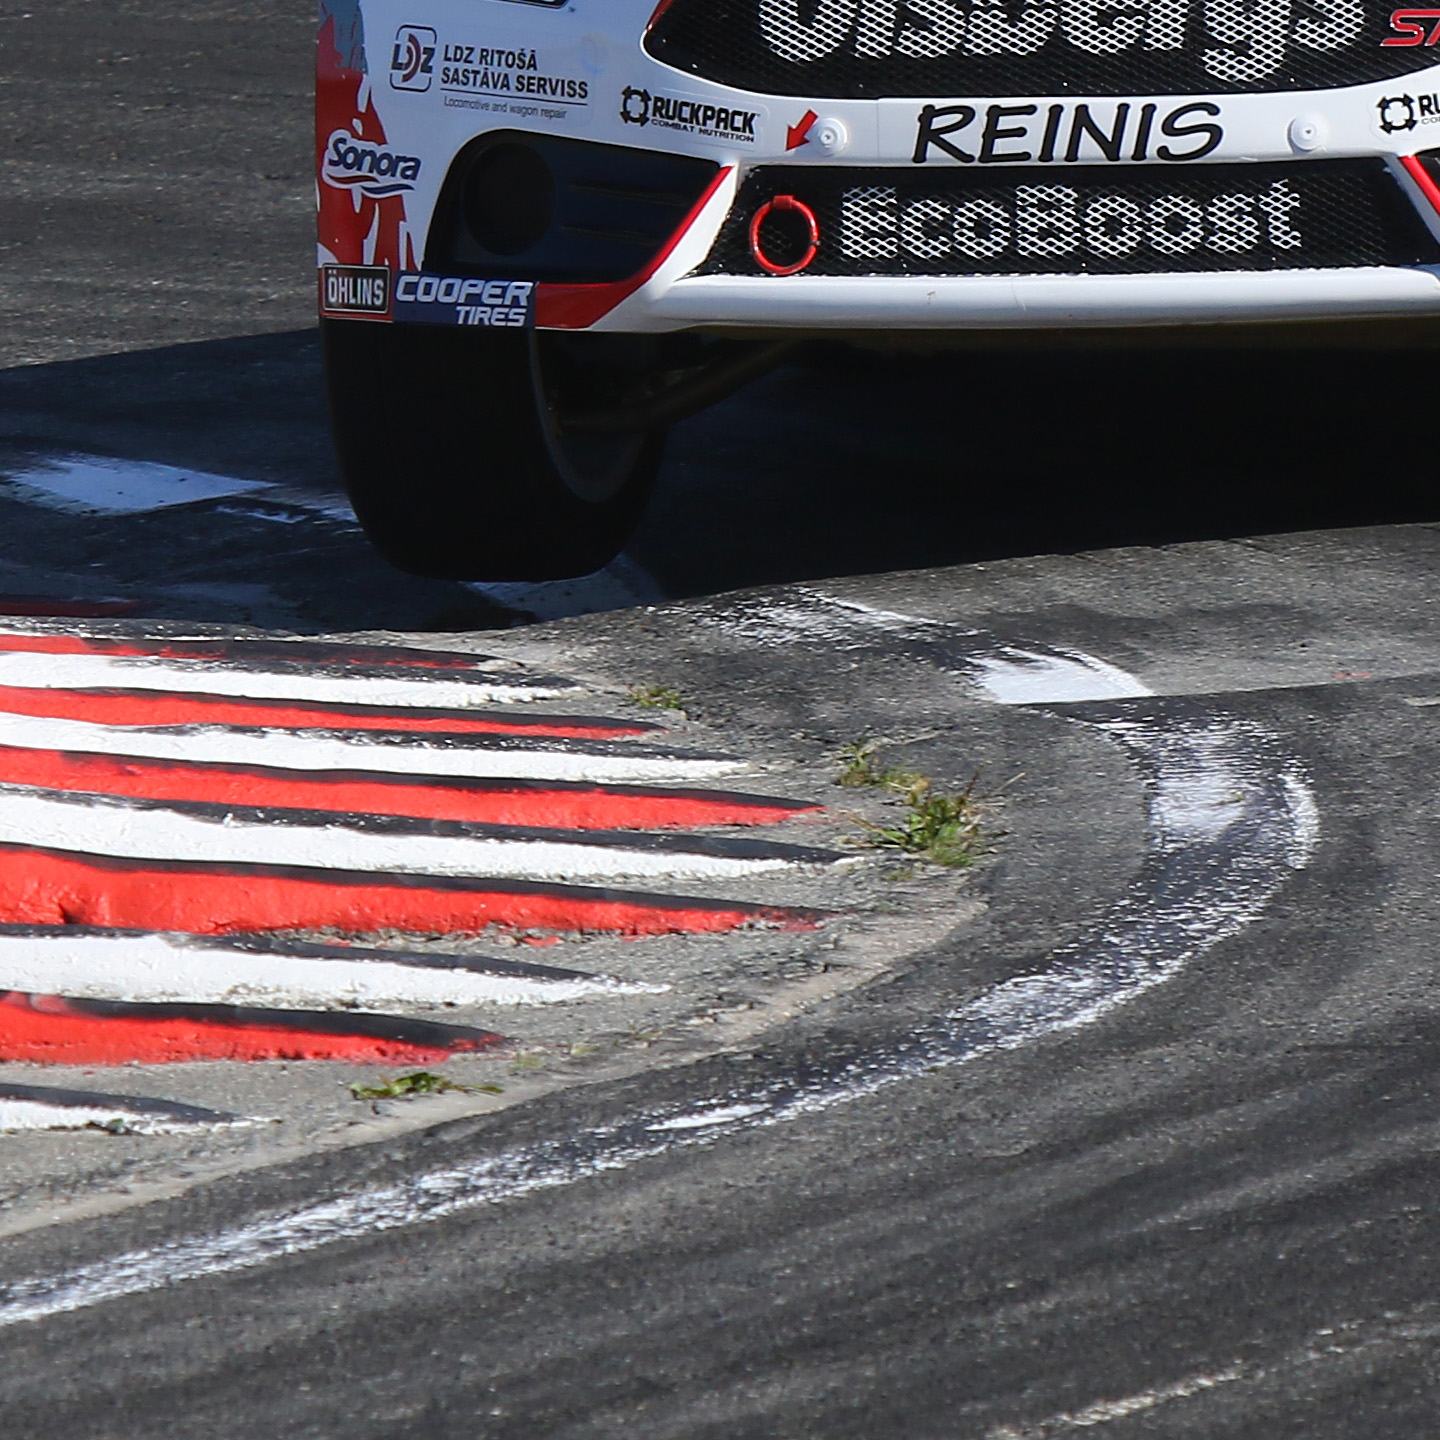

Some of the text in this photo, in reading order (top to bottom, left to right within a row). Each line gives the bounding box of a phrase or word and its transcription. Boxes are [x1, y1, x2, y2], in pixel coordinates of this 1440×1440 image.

[443, 45, 538, 71] LDZ RITOŠĀ
[441, 66, 588, 99] SASTĀVA SERVISS
[444, 95, 568, 120] Locomotive and wagon repair
[652, 96, 756, 135] RUCKPACK
[650, 117, 755, 143] COMBAT NUTRITION
[912, 101, 1224, 163] REINIS
[327, 136, 422, 182] Sonora
[840, 180, 1302, 260] EcoBoost
[327, 269, 385, 307] ÖHLINS
[396, 274, 534, 306] COOPER
[456, 306, 527, 327] TIRES
